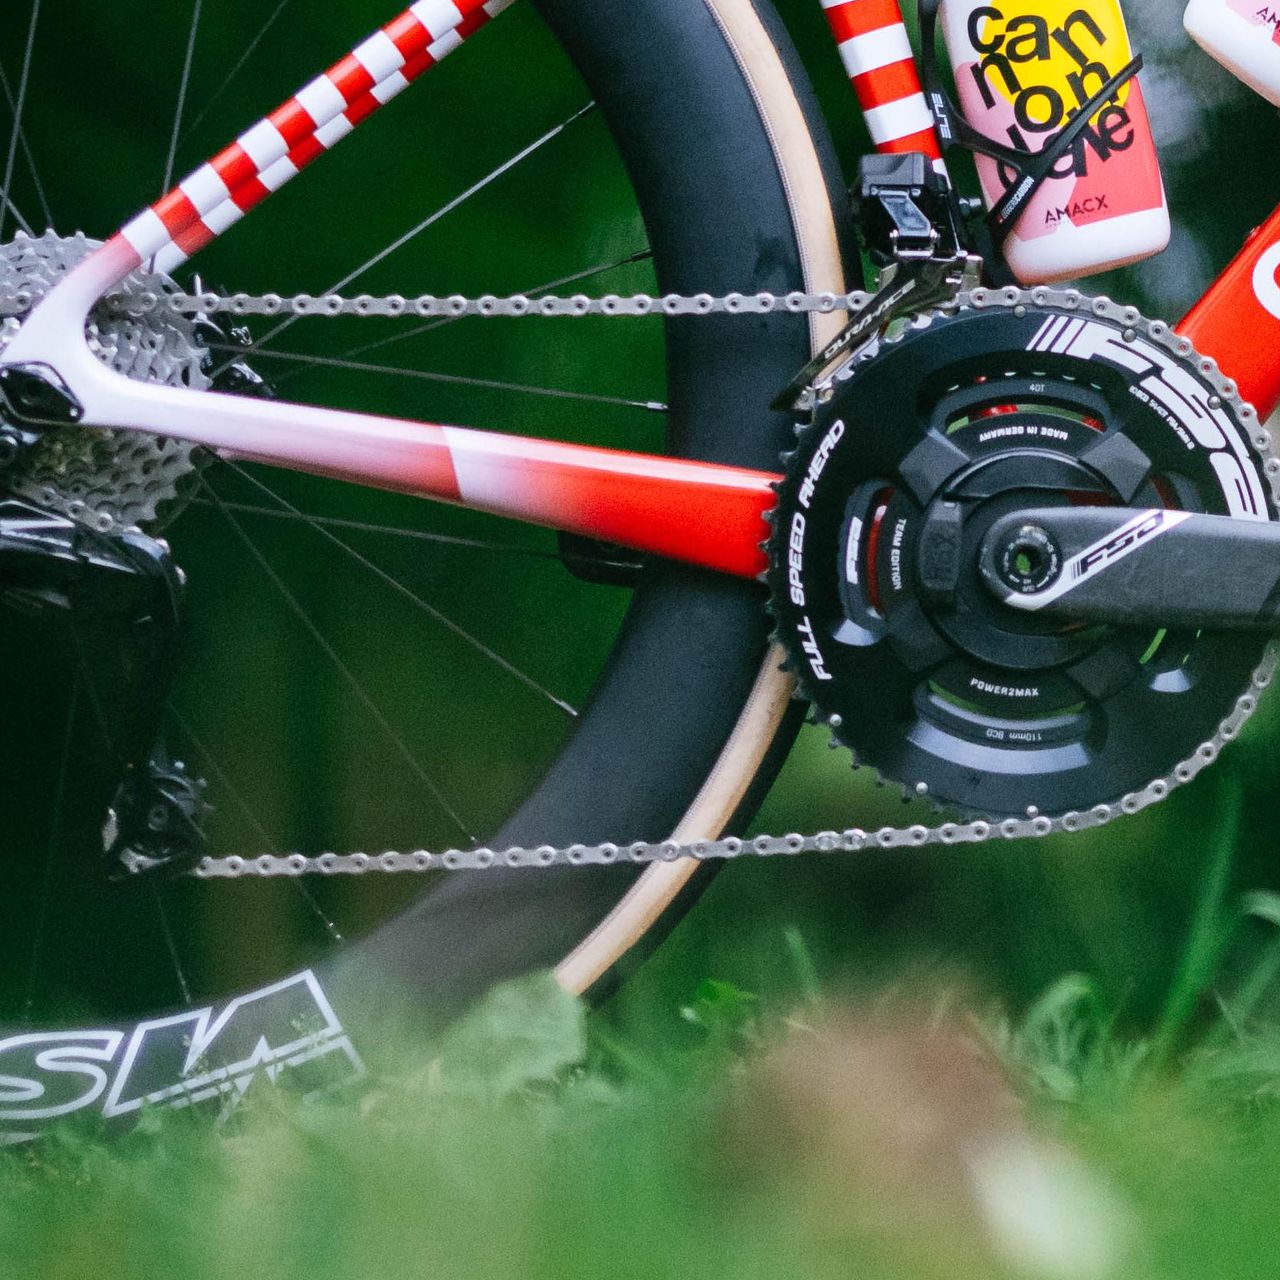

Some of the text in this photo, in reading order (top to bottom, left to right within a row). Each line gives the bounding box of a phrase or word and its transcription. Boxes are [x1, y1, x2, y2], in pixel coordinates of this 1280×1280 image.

[1044, 193, 1109, 224] AMACX
[1029, 383, 1046, 393] 40T
[979, 425, 1069, 443] MADE IN GERMANY
[788, 419, 846, 681] FULL SPEED AHEAD
[890, 518, 907, 590] TEAM EDITION
[970, 677, 1040, 697] POWER2MAX
[986, 727, 1042, 742] 110mm BCD
